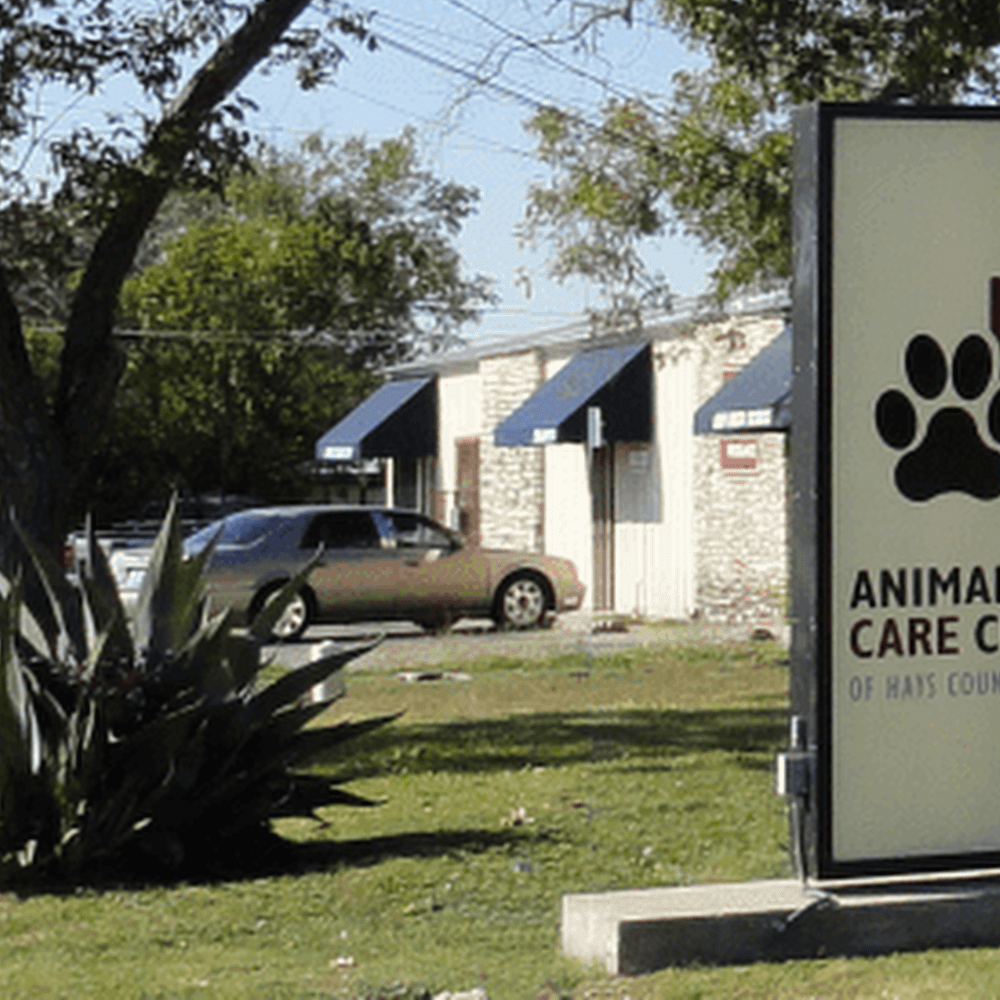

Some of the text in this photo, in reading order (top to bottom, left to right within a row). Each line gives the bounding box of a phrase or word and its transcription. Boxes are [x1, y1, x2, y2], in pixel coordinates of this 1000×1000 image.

[850, 616, 960, 658] CARE
[850, 676, 873, 701] OF
[886, 672, 936, 699] HAYS
